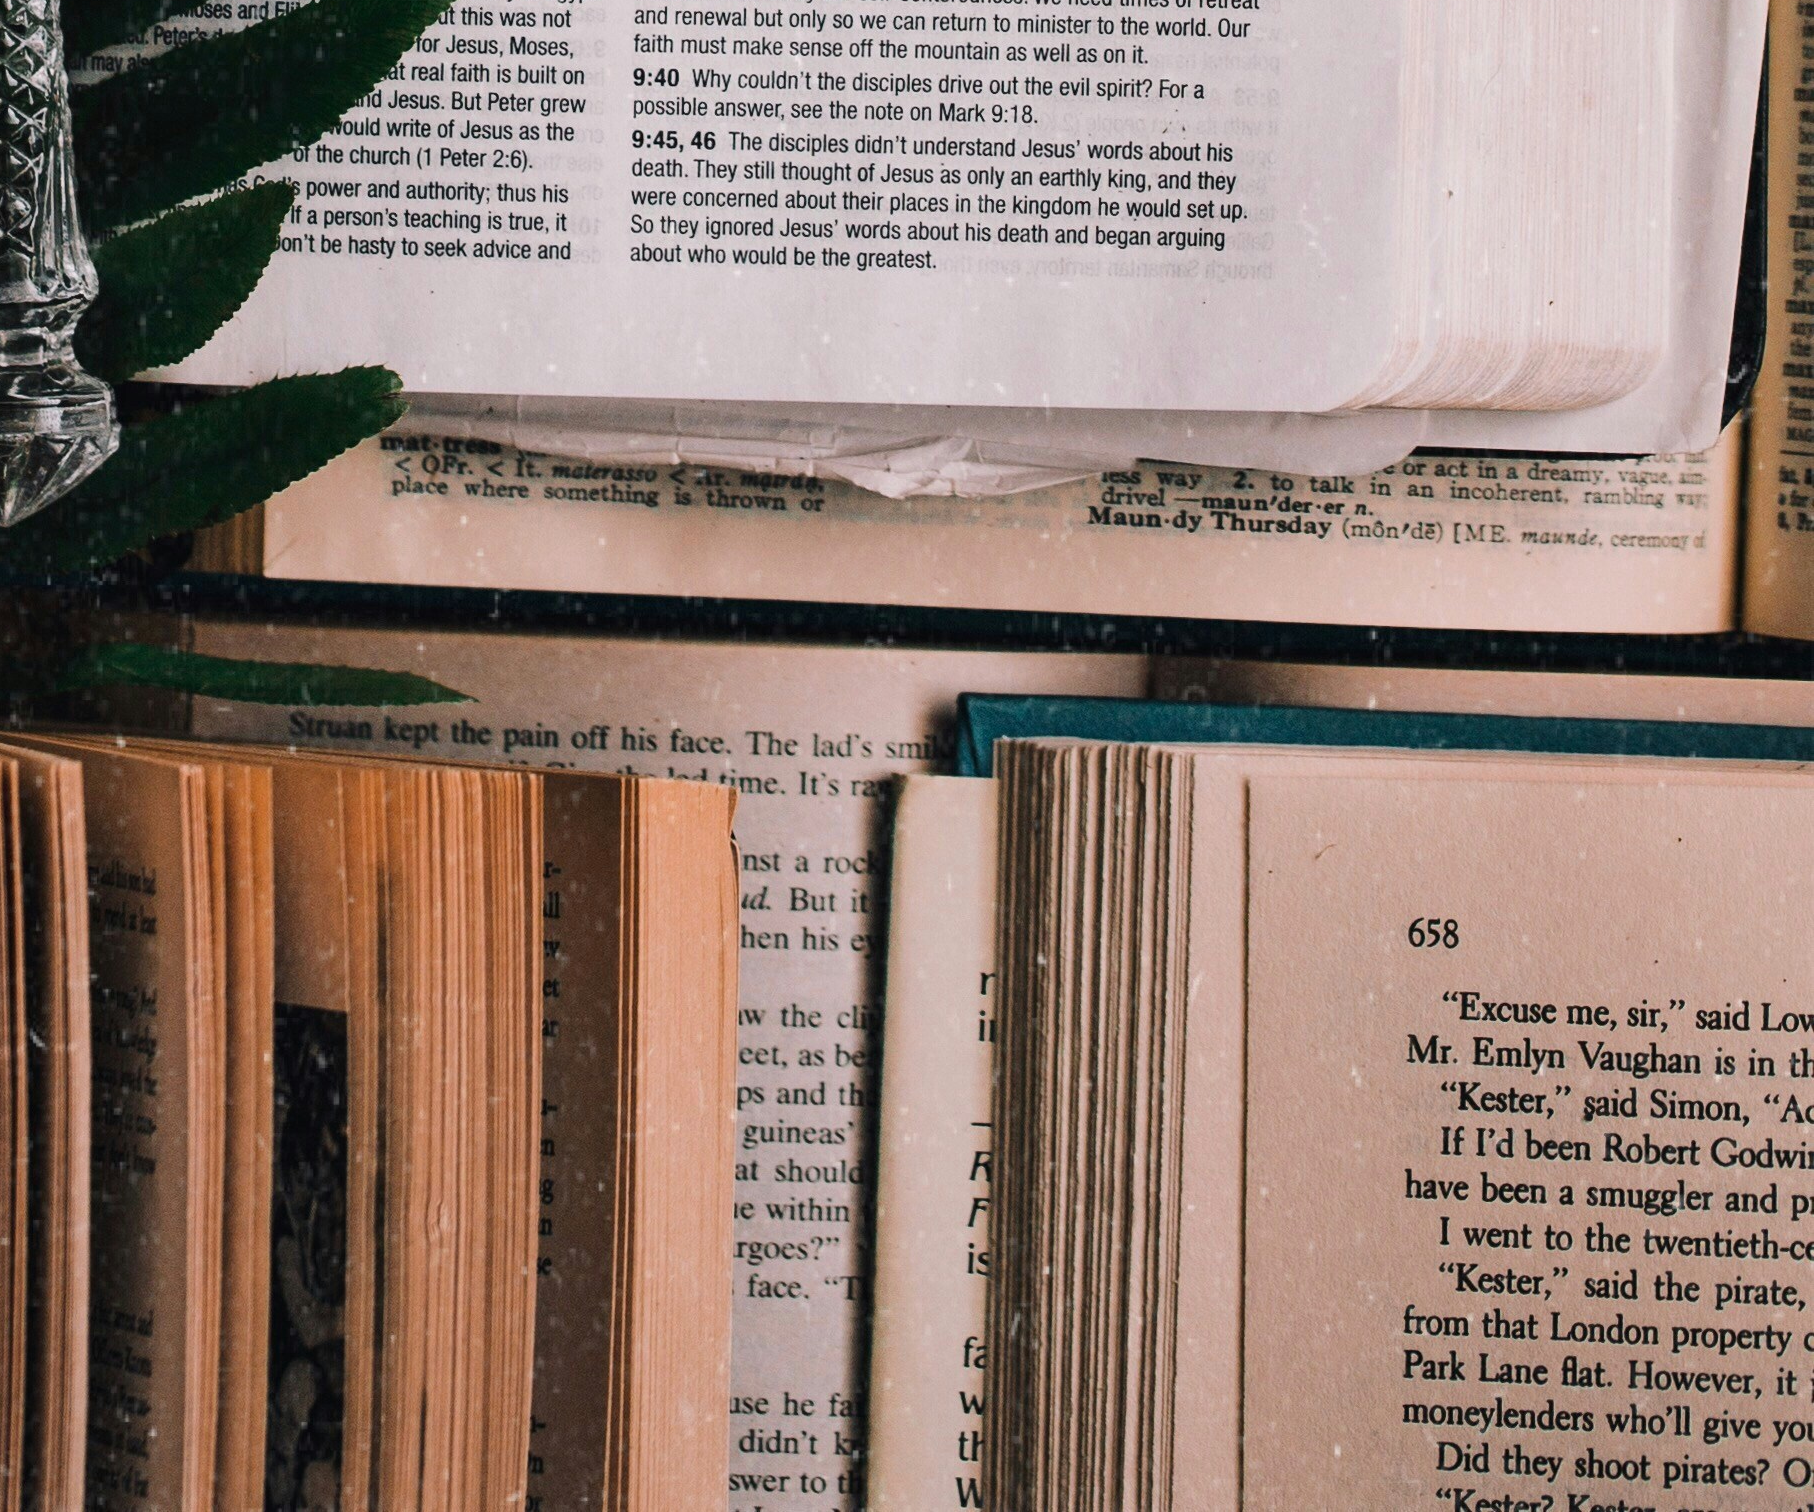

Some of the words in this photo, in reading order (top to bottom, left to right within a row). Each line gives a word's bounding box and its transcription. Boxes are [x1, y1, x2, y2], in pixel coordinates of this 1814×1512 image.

[630, 243, 681, 262] about
[688, 245, 726, 263] who
[733, 246, 786, 265] would
[794, 247, 815, 266] be
[822, 248, 850, 267] the
[857, 250, 936, 271] greatest.
[392, 475, 449, 497] place
[465, 478, 530, 499] where
[544, 482, 661, 509] something
[674, 486, 690, 507] is
[708, 488, 787, 512] thrown
[801, 494, 826, 513] or
[288, 713, 373, 743] Struan
[384, 717, 439, 749] kept
[451, 719, 491, 745] the
[503, 723, 559, 753] pain
[571, 725, 610, 750] off
[621, 726, 658, 752] his
[670, 728, 731, 754] face.
[745, 731, 798, 756] The
[813, 733, 872, 758] lad's
[1408, 918, 1459, 949] 658
[1567, 1006, 1617, 1031] me,
[1696, 1001, 1750, 1031] said
[1405, 1168, 1469, 1200] have
[1481, 1172, 1546, 1204] been
[1559, 1186, 1574, 1205] a
[1587, 1180, 1713, 1216] smuggler
[1725, 1183, 1778, 1213] and
[1436, 1442, 1490, 1473] Did
[1503, 1444, 1563, 1482] they
[1575, 1448, 1651, 1481] shoot
[1663, 1454, 1769, 1489] pirates?
